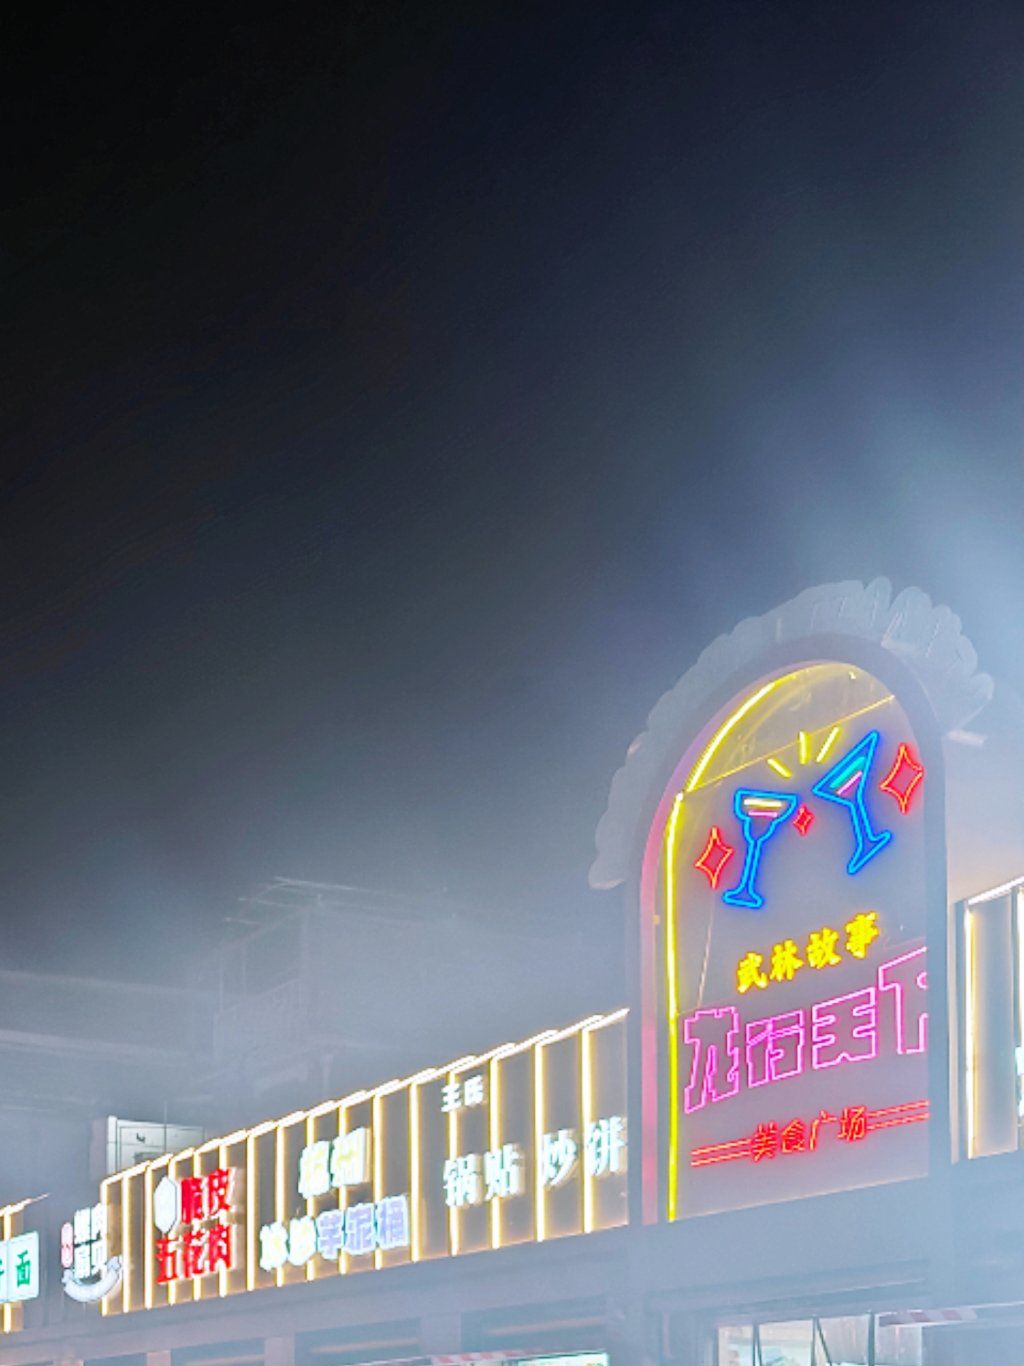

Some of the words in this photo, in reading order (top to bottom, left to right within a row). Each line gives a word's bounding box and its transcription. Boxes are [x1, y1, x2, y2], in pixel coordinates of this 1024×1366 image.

[736, 911, 879, 993] 武林故事
[443, 1116, 626, 1207] 锅贴炒饼
[751, 1106, 867, 1161] 美食广场
[180, 1168, 232, 1224] 脆皮
[155, 1224, 232, 1284] 五花肉
